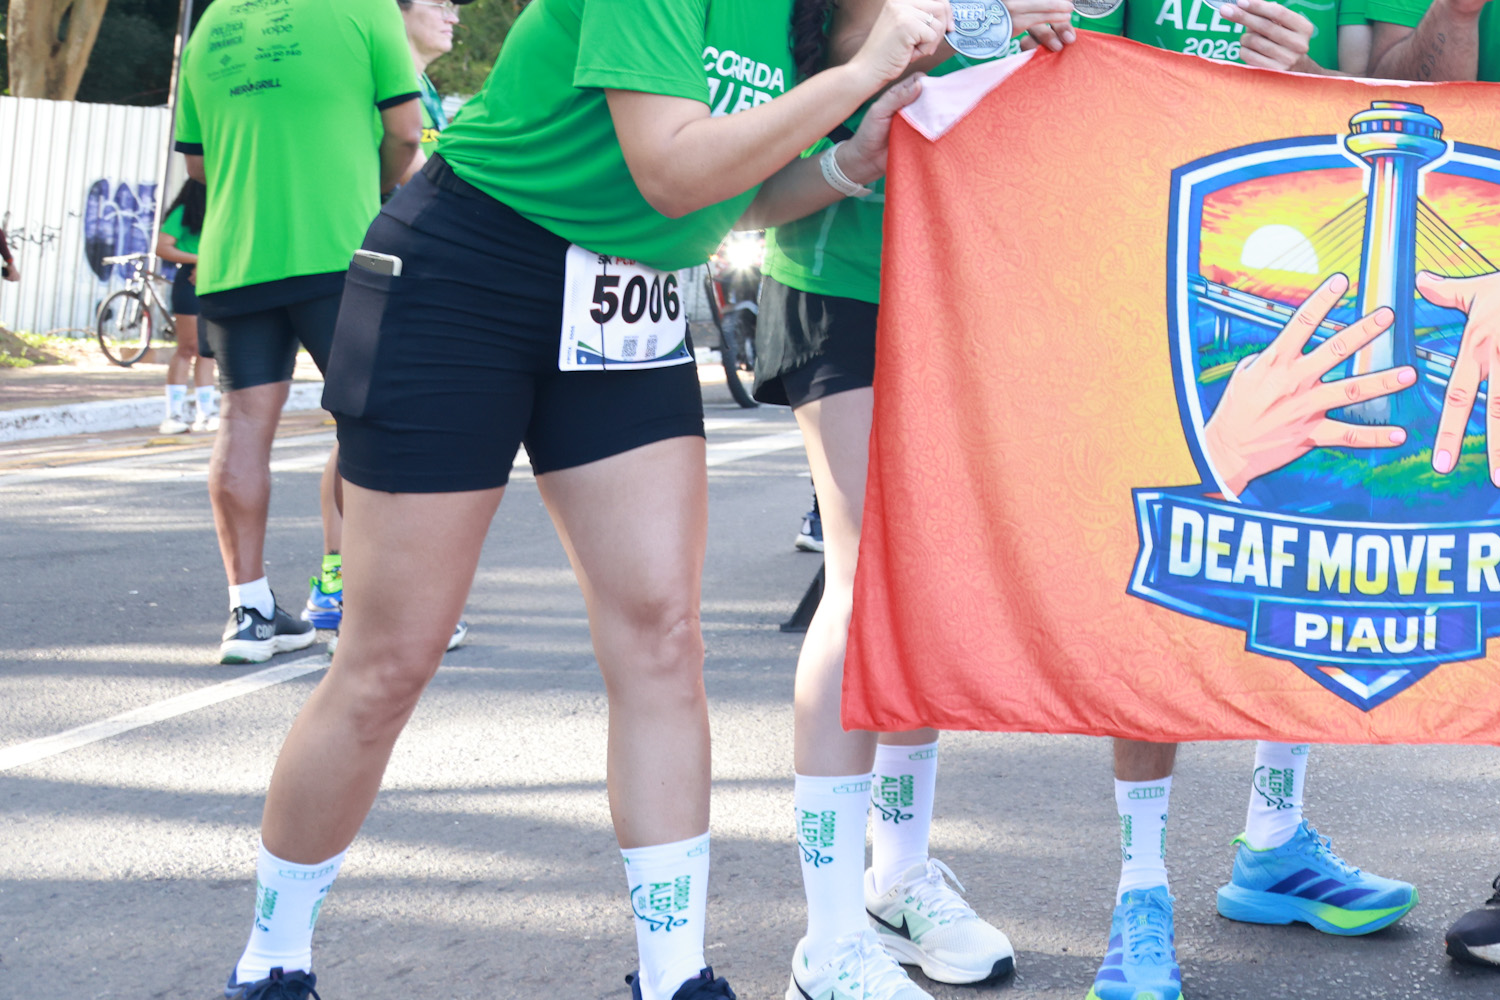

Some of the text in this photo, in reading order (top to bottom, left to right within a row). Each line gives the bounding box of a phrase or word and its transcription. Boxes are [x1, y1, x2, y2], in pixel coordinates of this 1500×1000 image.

[1182, 37, 1241, 60] 2026
[701, 46, 785, 93] CORRIDA
[590, 273, 680, 324] 5006
[1168, 506, 1300, 589] DEAF
[1306, 530, 1455, 596] MOVE
[1293, 605, 1437, 654] PIAUÍ
[881, 775, 898, 807] ALEPI
[1268, 767, 1282, 797] ALEPI
[801, 809, 819, 848] ALEPI
[649, 882, 673, 917] ALEPI
